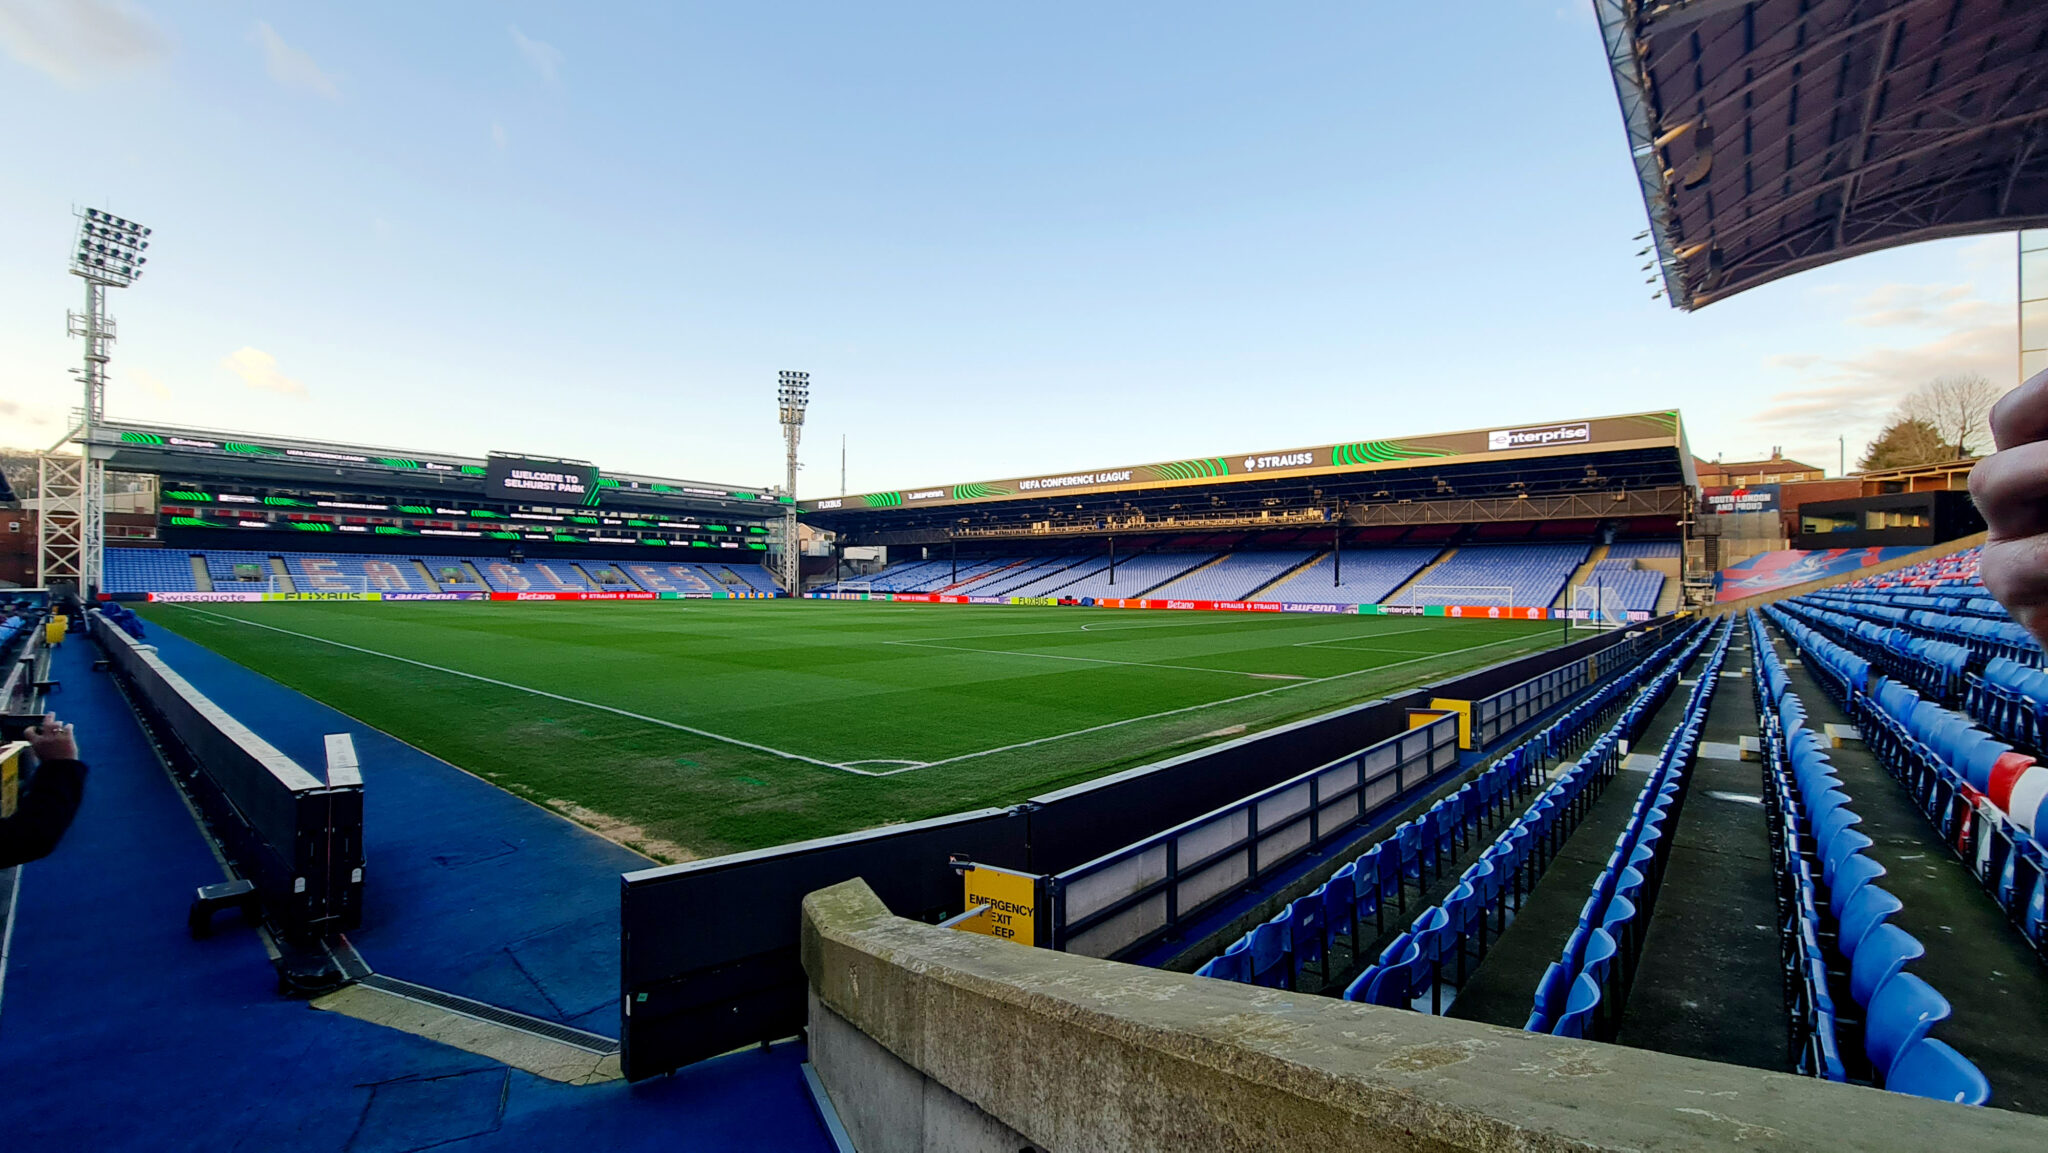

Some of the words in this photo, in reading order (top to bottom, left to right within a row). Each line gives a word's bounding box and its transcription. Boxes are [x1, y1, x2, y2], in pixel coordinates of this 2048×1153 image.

[1495, 427, 1587, 444] enterprise
[1257, 452, 1313, 469] STRAUSS
[511, 469, 563, 483] WELCOME
[564, 474, 579, 484] TO
[1019, 480, 1040, 490] UEFA
[1041, 475, 1095, 488] CONFERENCE
[1096, 471, 1131, 483] LEAGUE
[504, 478, 556, 491] SELHURST
[557, 483, 585, 494] PARK
[1708, 495, 1735, 504] SOUTH
[1736, 493, 1772, 503] LONDON
[1716, 503, 1734, 511] AND
[1735, 502, 1763, 511] PROUD
[156, 591, 246, 601] Swissquote
[516, 592, 556, 601] Betano
[1166, 600, 1195, 610] Betano
[969, 893, 1034, 918] EMERGENCY
[991, 911, 1013, 926] EXIT
